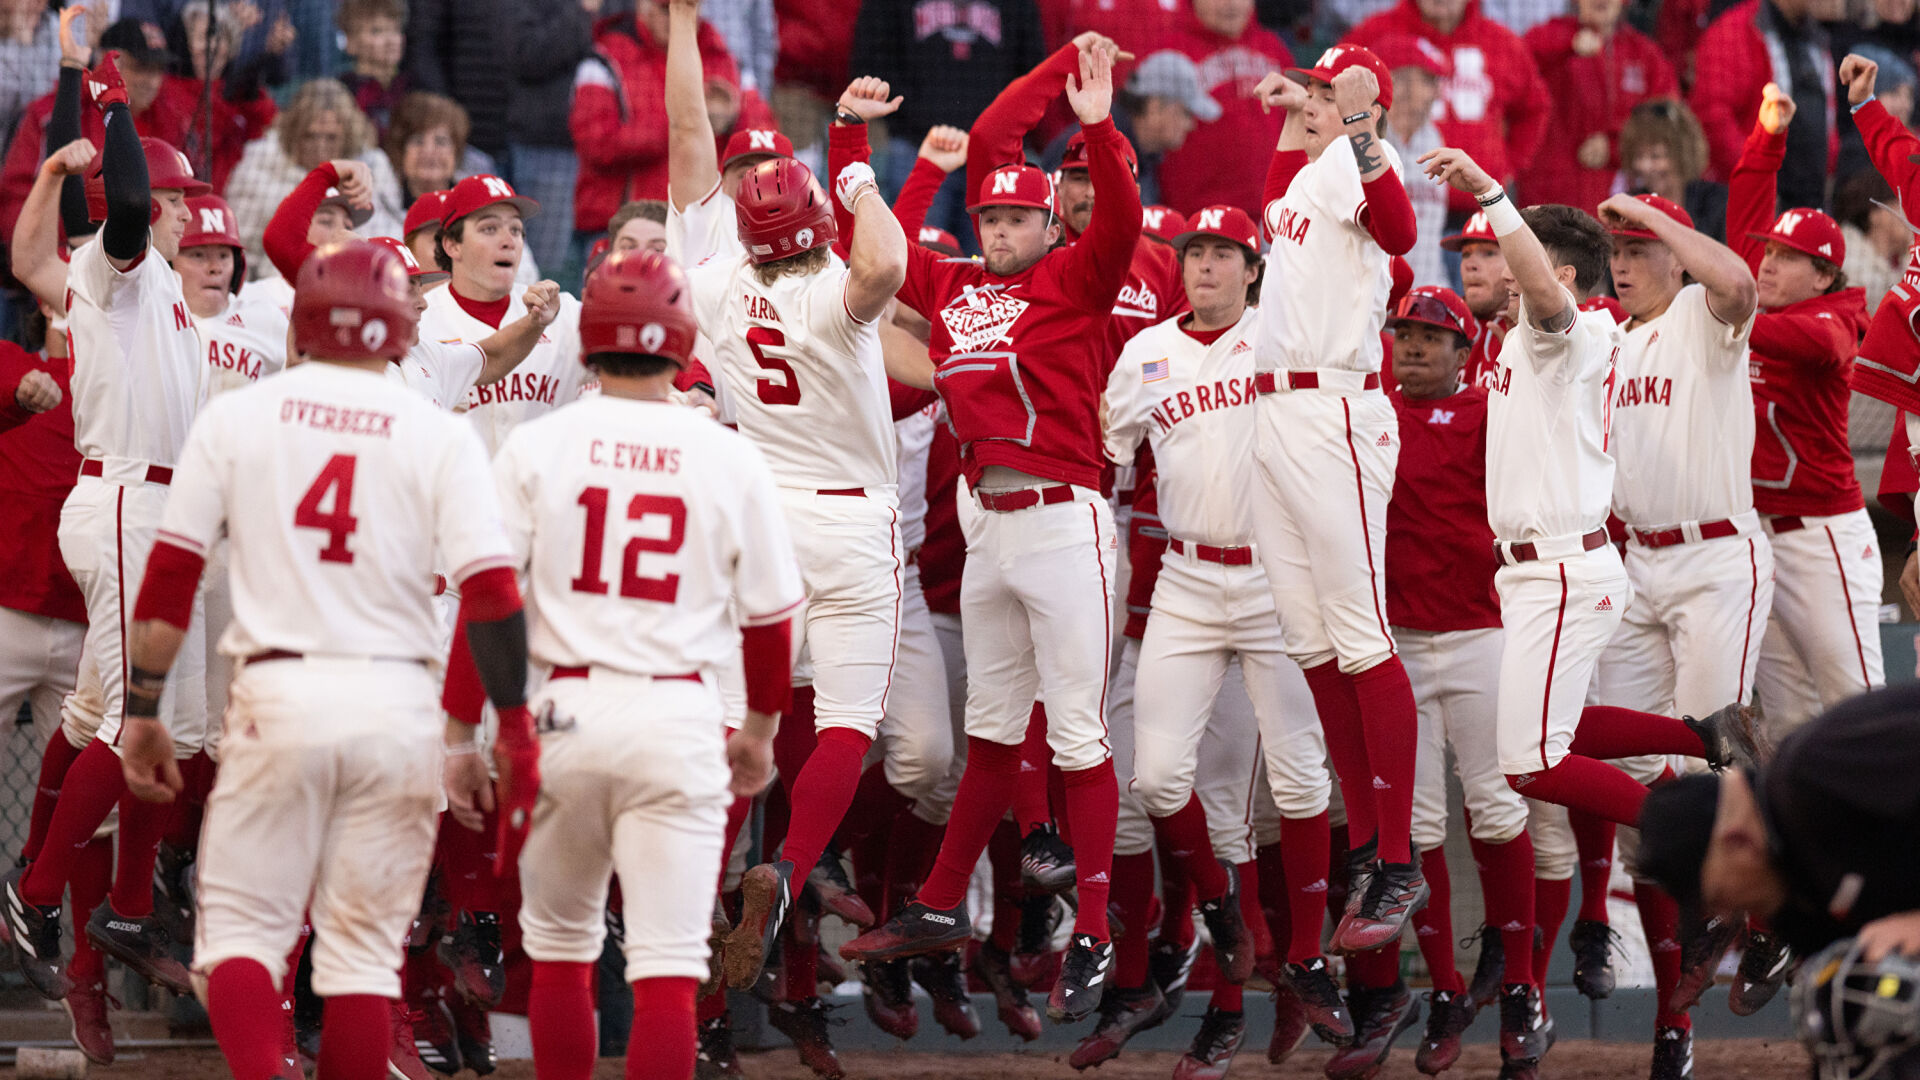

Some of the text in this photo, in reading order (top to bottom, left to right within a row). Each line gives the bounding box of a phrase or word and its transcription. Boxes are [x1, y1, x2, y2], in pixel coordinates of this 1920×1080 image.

[1315, 48, 1345, 69] N
[749, 130, 776, 149] N
[482, 177, 512, 197] N
[992, 172, 1019, 195] N
[200, 208, 226, 232] N
[1142, 209, 1165, 229] N
[1197, 209, 1225, 230] N
[1466, 211, 1488, 233] N
[1774, 212, 1802, 236] N
[779, 236, 791, 250] 5
[396, 245, 420, 268] N
[746, 327, 801, 405] 5
[1428, 408, 1455, 425] N
[590, 440, 682, 474] C. EVANS
[294, 452, 358, 565] 4
[571, 486, 688, 605] 12
[106, 920, 142, 933] ADIZERO
[921, 912, 956, 926] ADIZERO
